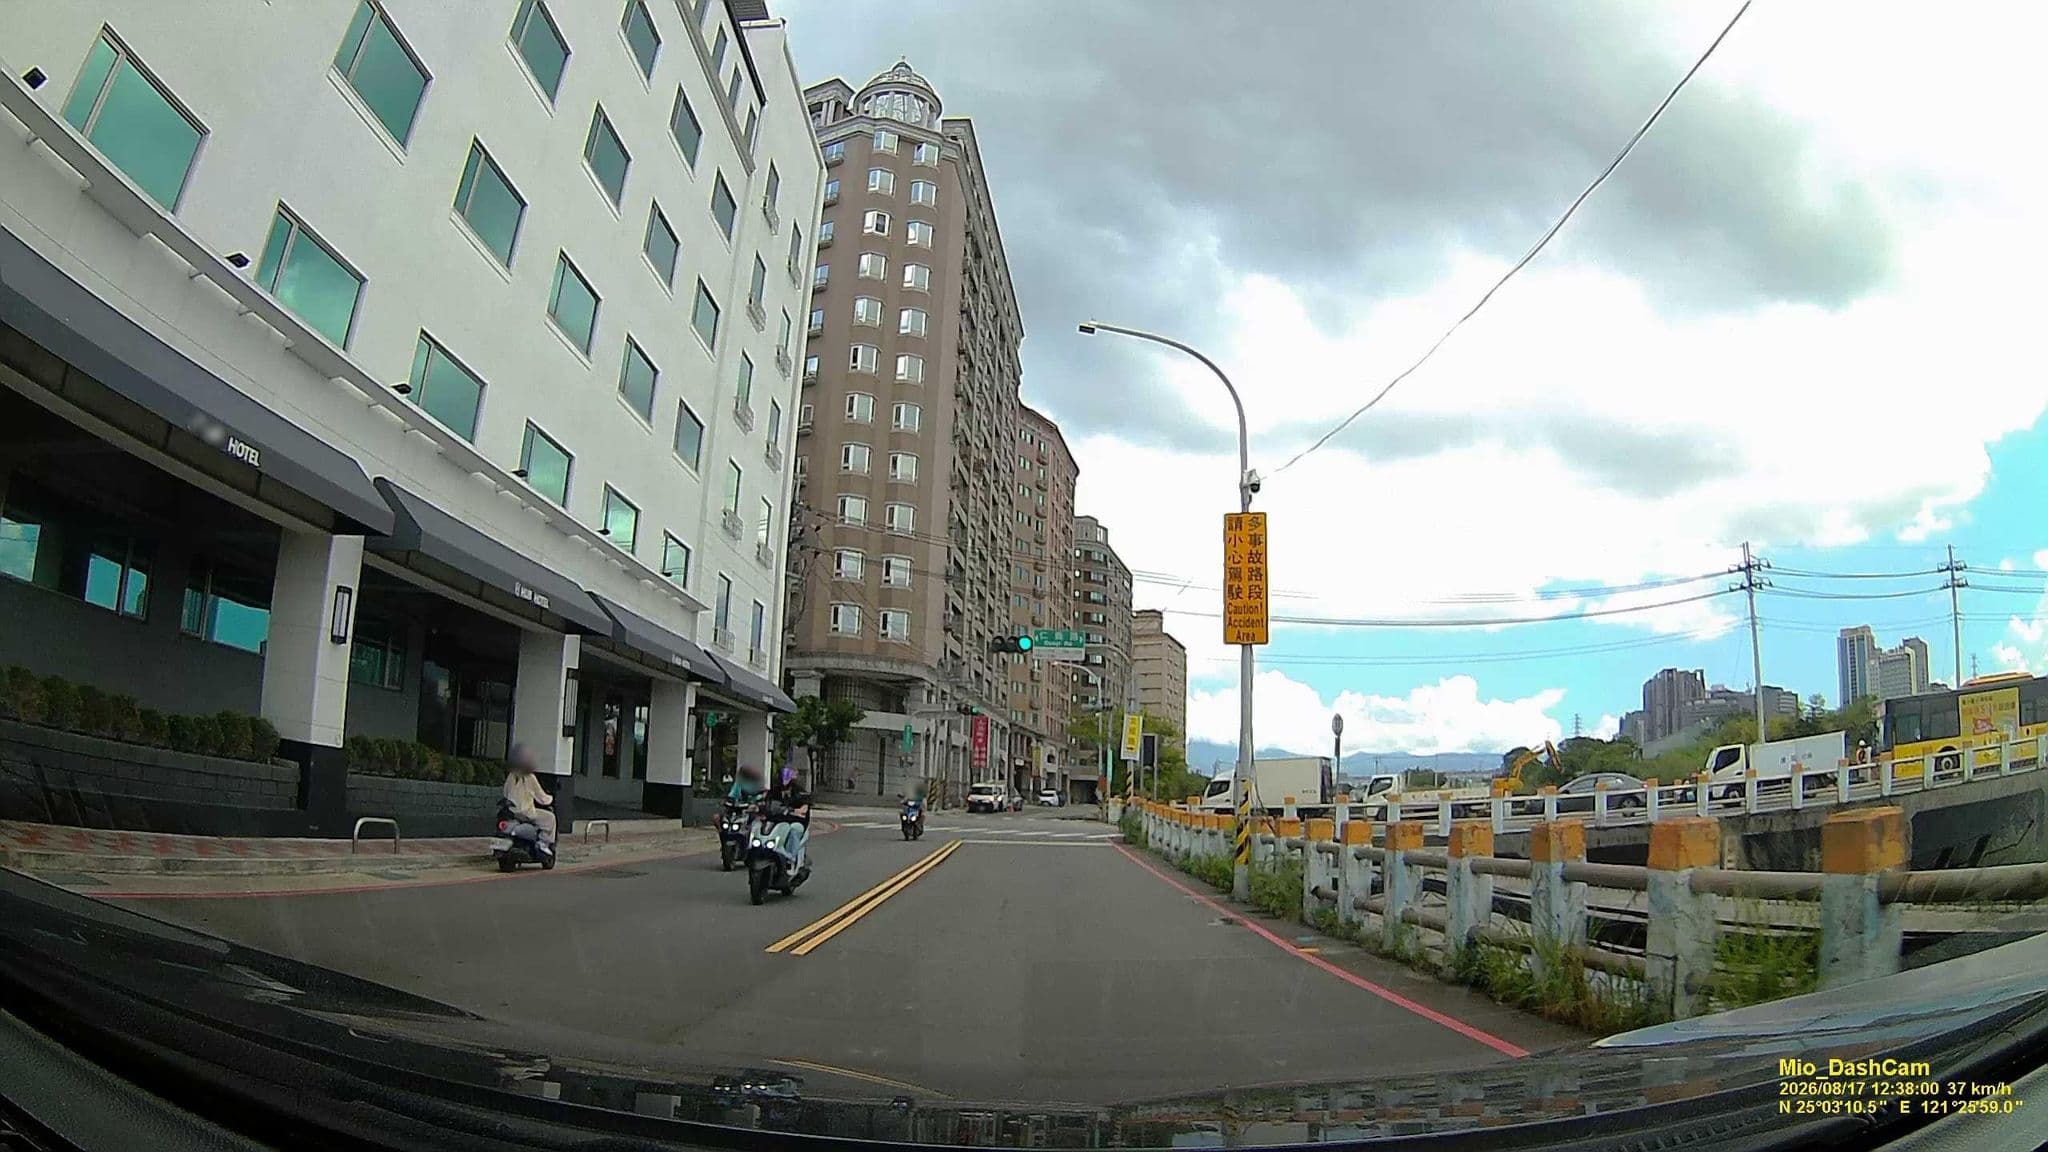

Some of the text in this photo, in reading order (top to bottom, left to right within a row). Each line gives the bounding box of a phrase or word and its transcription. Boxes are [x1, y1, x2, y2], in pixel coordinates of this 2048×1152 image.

[228, 437, 260, 467] HOTEL
[1227, 516, 1244, 601] 請小心駕駛
[1247, 516, 1264, 601] 多事故路段
[1227, 603, 1263, 615] Caution!
[1227, 616, 1264, 629] Accident
[1236, 630, 1256, 642] Area
